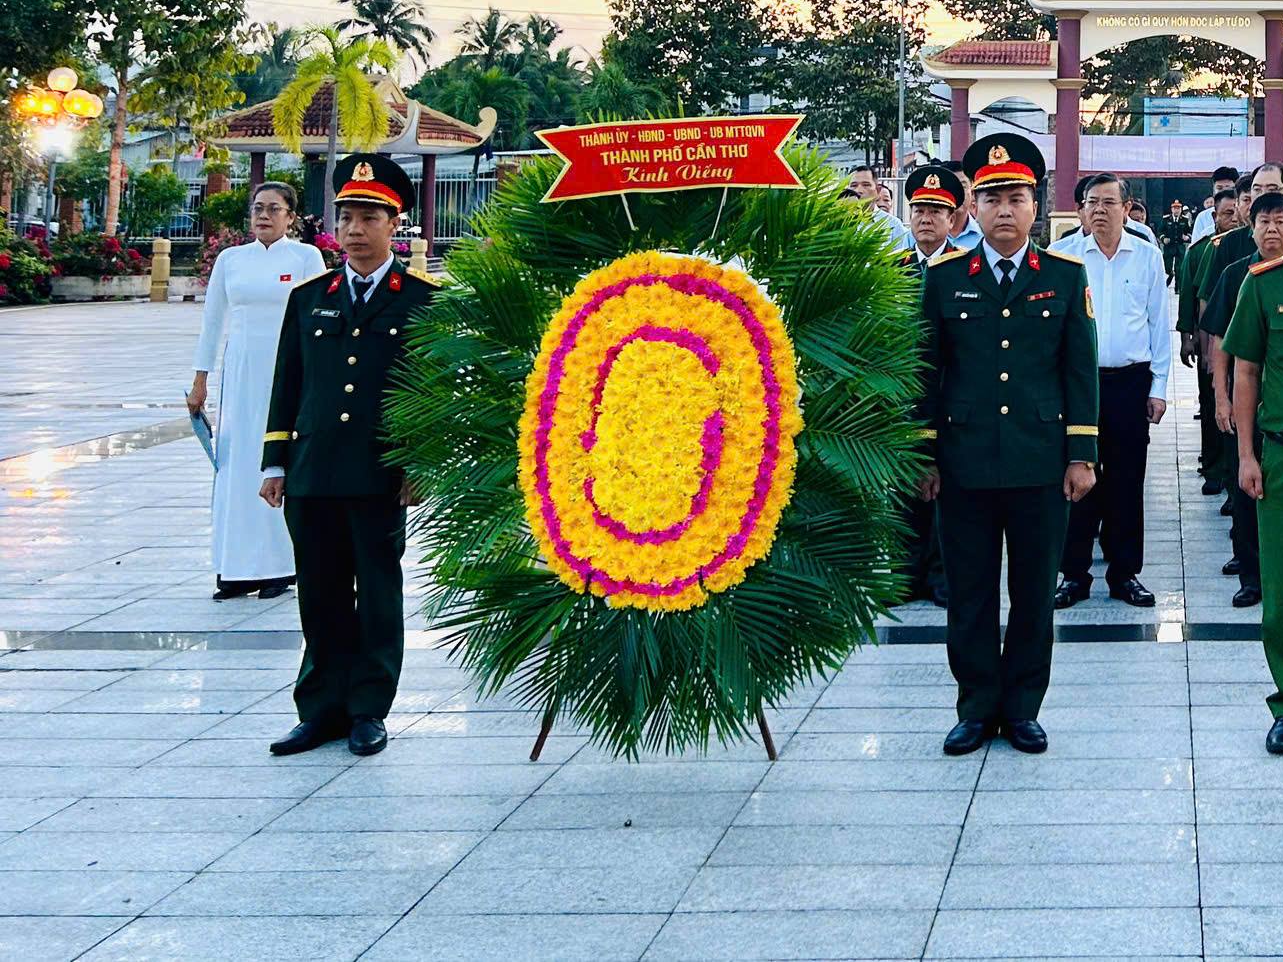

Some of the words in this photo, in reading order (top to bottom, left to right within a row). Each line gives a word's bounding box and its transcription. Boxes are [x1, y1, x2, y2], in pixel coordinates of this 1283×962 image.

[1238, 17, 1251, 27] DO
[579, 131, 614, 148] THÀNH
[616, 128, 629, 143] ỦY
[638, 129, 665, 142] HĐND
[673, 127, 701, 141] UBND
[710, 126, 723, 138] UB
[725, 125, 765, 137] MTTQVN
[600, 147, 650, 166] THÀNH
[653, 144, 684, 162] PHỐ
[686, 143, 717, 160] CẦN
[719, 144, 748, 158] THƠ
[675, 164, 733, 181] Viếng
